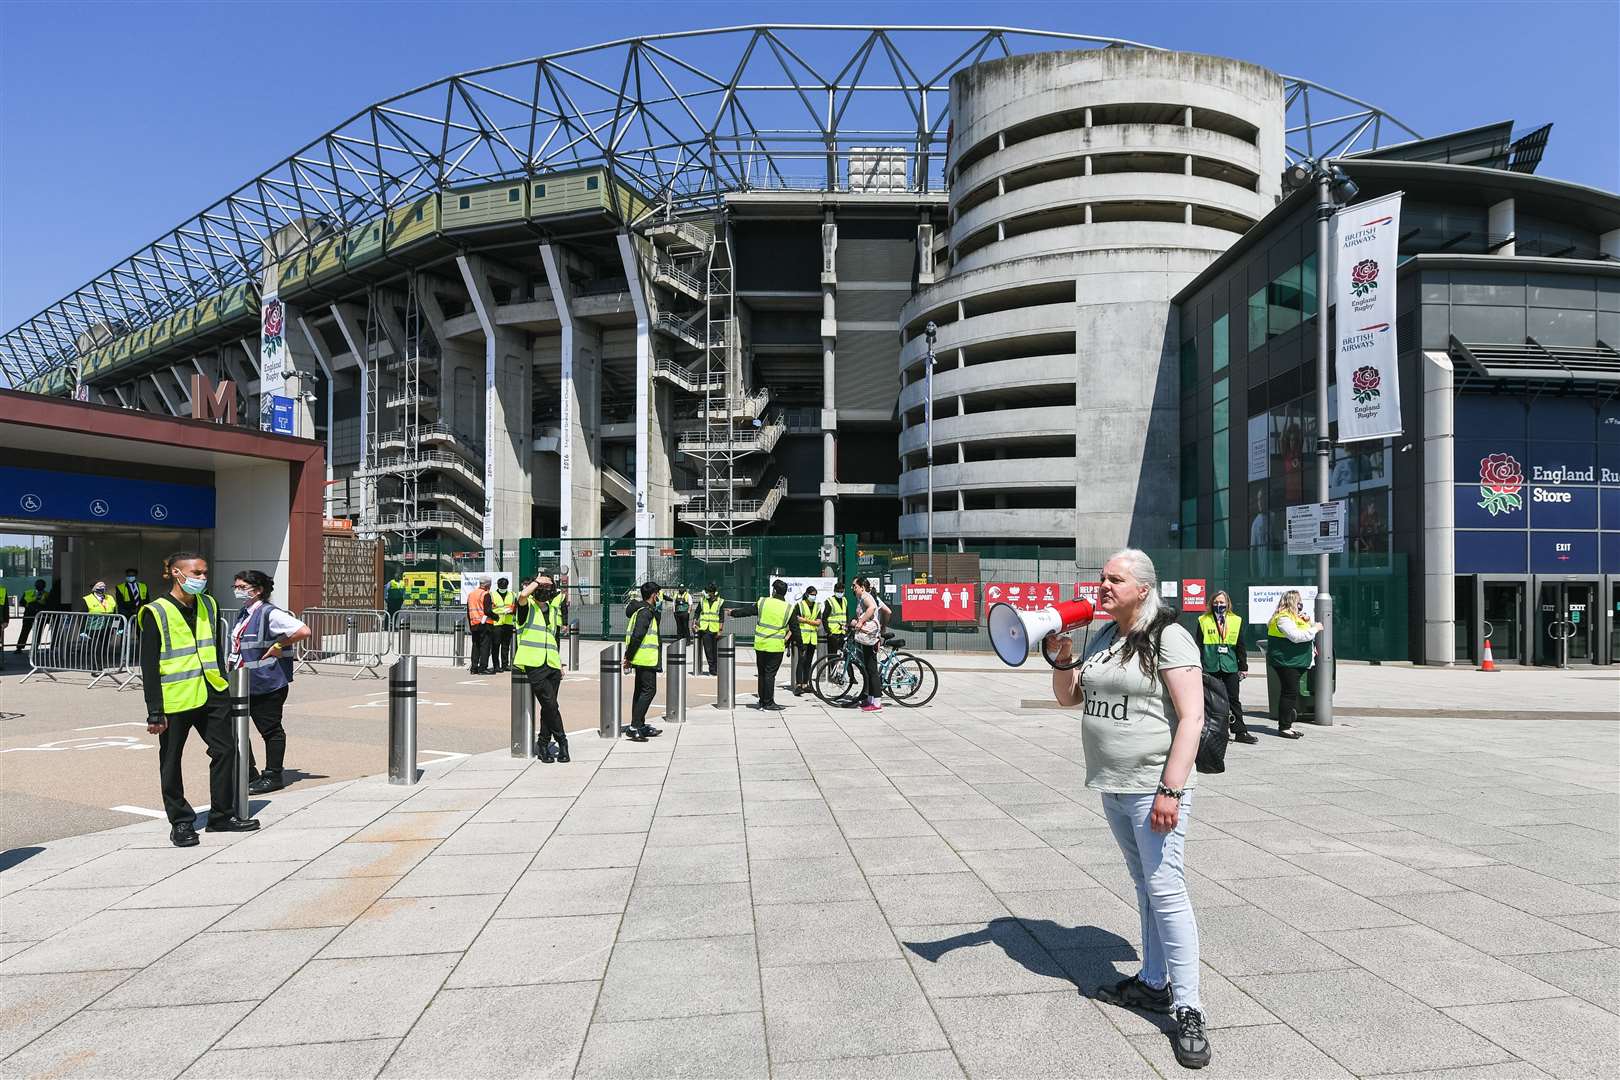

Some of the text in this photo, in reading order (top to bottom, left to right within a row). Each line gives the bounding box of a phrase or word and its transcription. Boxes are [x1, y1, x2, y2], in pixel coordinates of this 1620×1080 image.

[1345, 227, 1376, 241] BRITISH
[1343, 235, 1376, 248] AIRWAYS
[1351, 295, 1377, 308] England
[1354, 303, 1374, 313] Rugby
[1342, 333, 1374, 346] BRITISH
[1341, 341, 1375, 353] AIRWAYS
[264, 360, 282, 372] England
[265, 371, 281, 384] Rugby
[191, 374, 237, 424] M
[1354, 404, 1380, 414] England
[1357, 411, 1378, 420] Rugby
[1533, 466, 1620, 484] England Ru
[1533, 488, 1571, 503] Store
[1556, 543, 1571, 552] EXIT
[1079, 585, 1092, 594] HELP
[1083, 689, 1129, 721] kind
